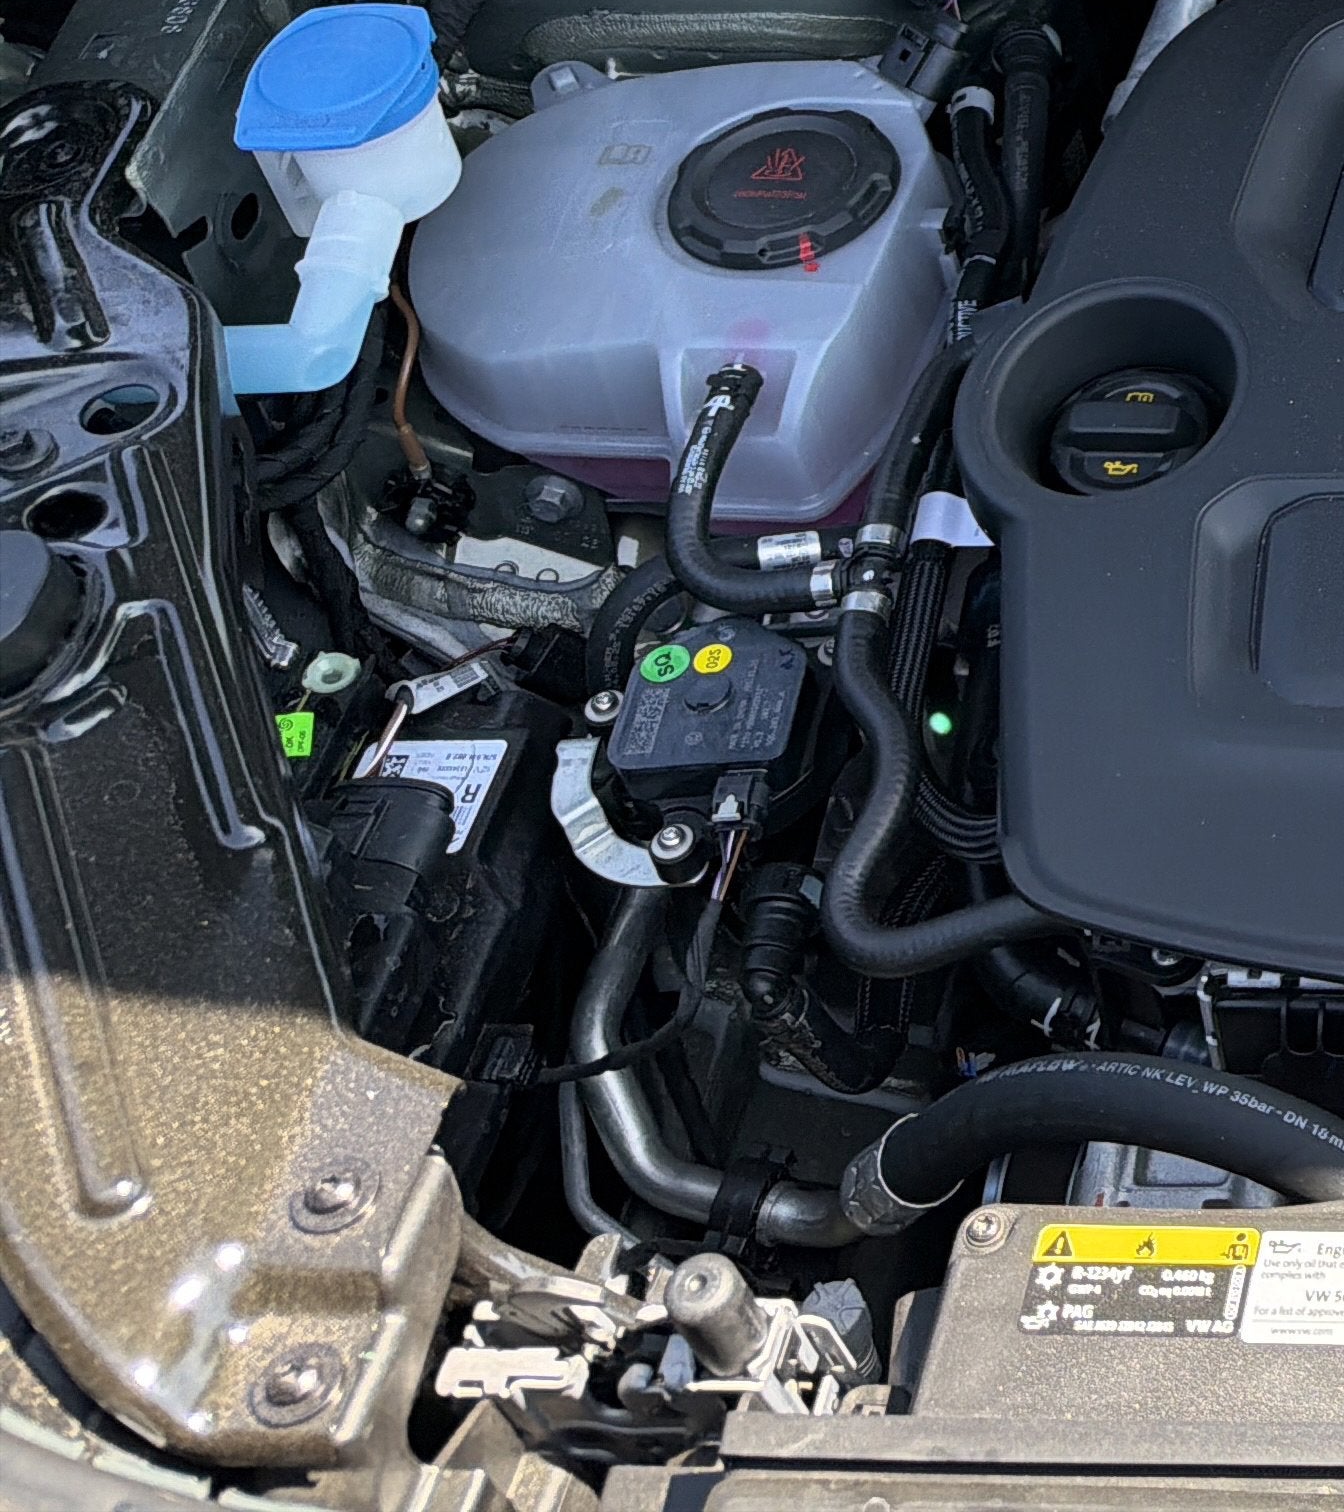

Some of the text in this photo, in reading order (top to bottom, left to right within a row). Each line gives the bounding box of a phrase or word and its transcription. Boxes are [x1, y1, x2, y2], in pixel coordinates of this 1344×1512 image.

[652, 650, 675, 677] SQ
[461, 784, 482, 803] R
[1096, 1062, 1138, 1076] ARTIC
[1141, 1067, 1167, 1080] NK
[1165, 1073, 1200, 1088] LEV
[1203, 1080, 1229, 1096] WP
[1230, 1090, 1274, 1117] 35bar
[1282, 1111, 1309, 1130] DN
[1305, 1290, 1331, 1302] VW
[1062, 1304, 1095, 1318] PAG
[1185, 1320, 1211, 1333] VW
